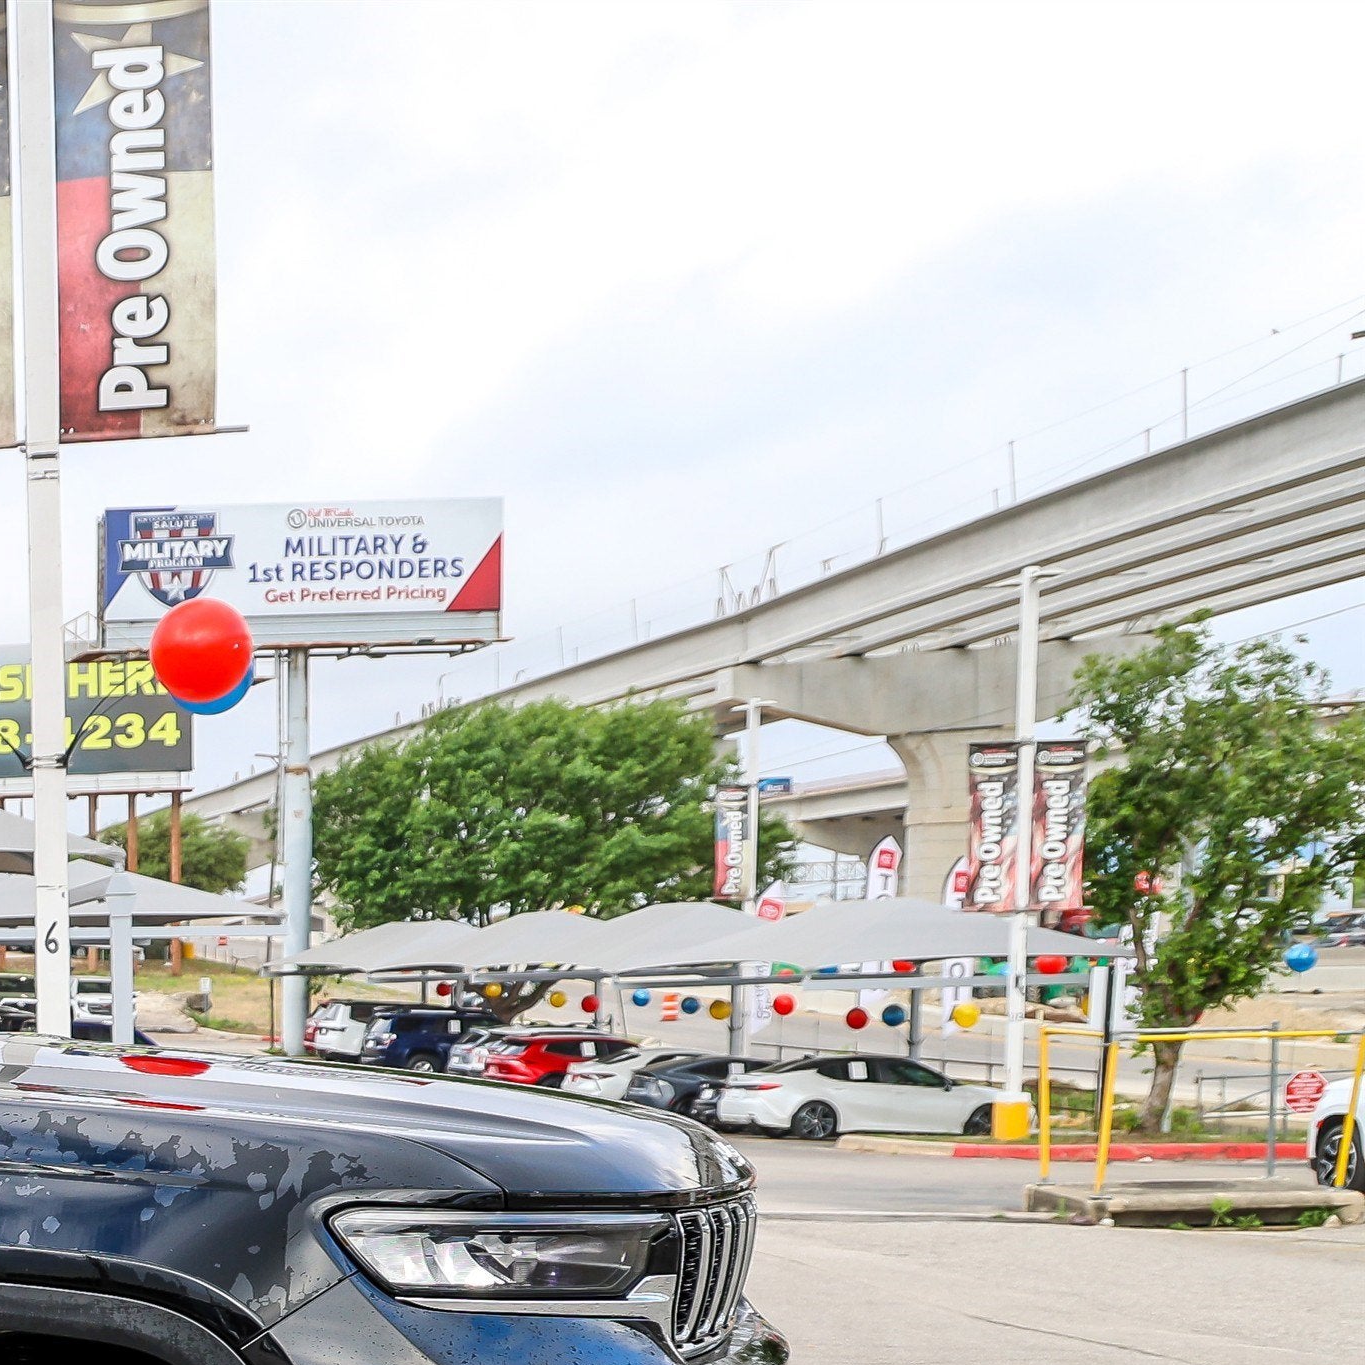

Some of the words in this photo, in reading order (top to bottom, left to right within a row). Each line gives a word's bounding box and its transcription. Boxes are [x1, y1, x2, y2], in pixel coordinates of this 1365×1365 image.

[92, 45, 168, 281] Owned
[99, 295, 169, 412] Pre
[153, 519, 198, 529] SALUTE
[308, 517, 376, 528] UNIVERSAL
[379, 516, 425, 526] TOYOTA
[122, 539, 228, 560] MILITARY
[285, 534, 406, 557] MILITARY
[412, 533, 428, 554] &
[149, 555, 203, 568] PROGRAM
[248, 562, 284, 583] 1st
[291, 557, 465, 581] RESPONDERS
[265, 588, 295, 603] Get
[300, 586, 381, 602] Preferred
[387, 584, 447, 602] Pricing
[69, 660, 168, 698] HER
[977, 780, 1004, 862] Owned
[1042, 779, 1071, 860] Owned
[724, 810, 743, 866] Owned
[720, 867, 742, 895] Pre
[973, 863, 1001, 903] Pre
[1038, 861, 1066, 901] Pre
[45, 921, 59, 953] 6
